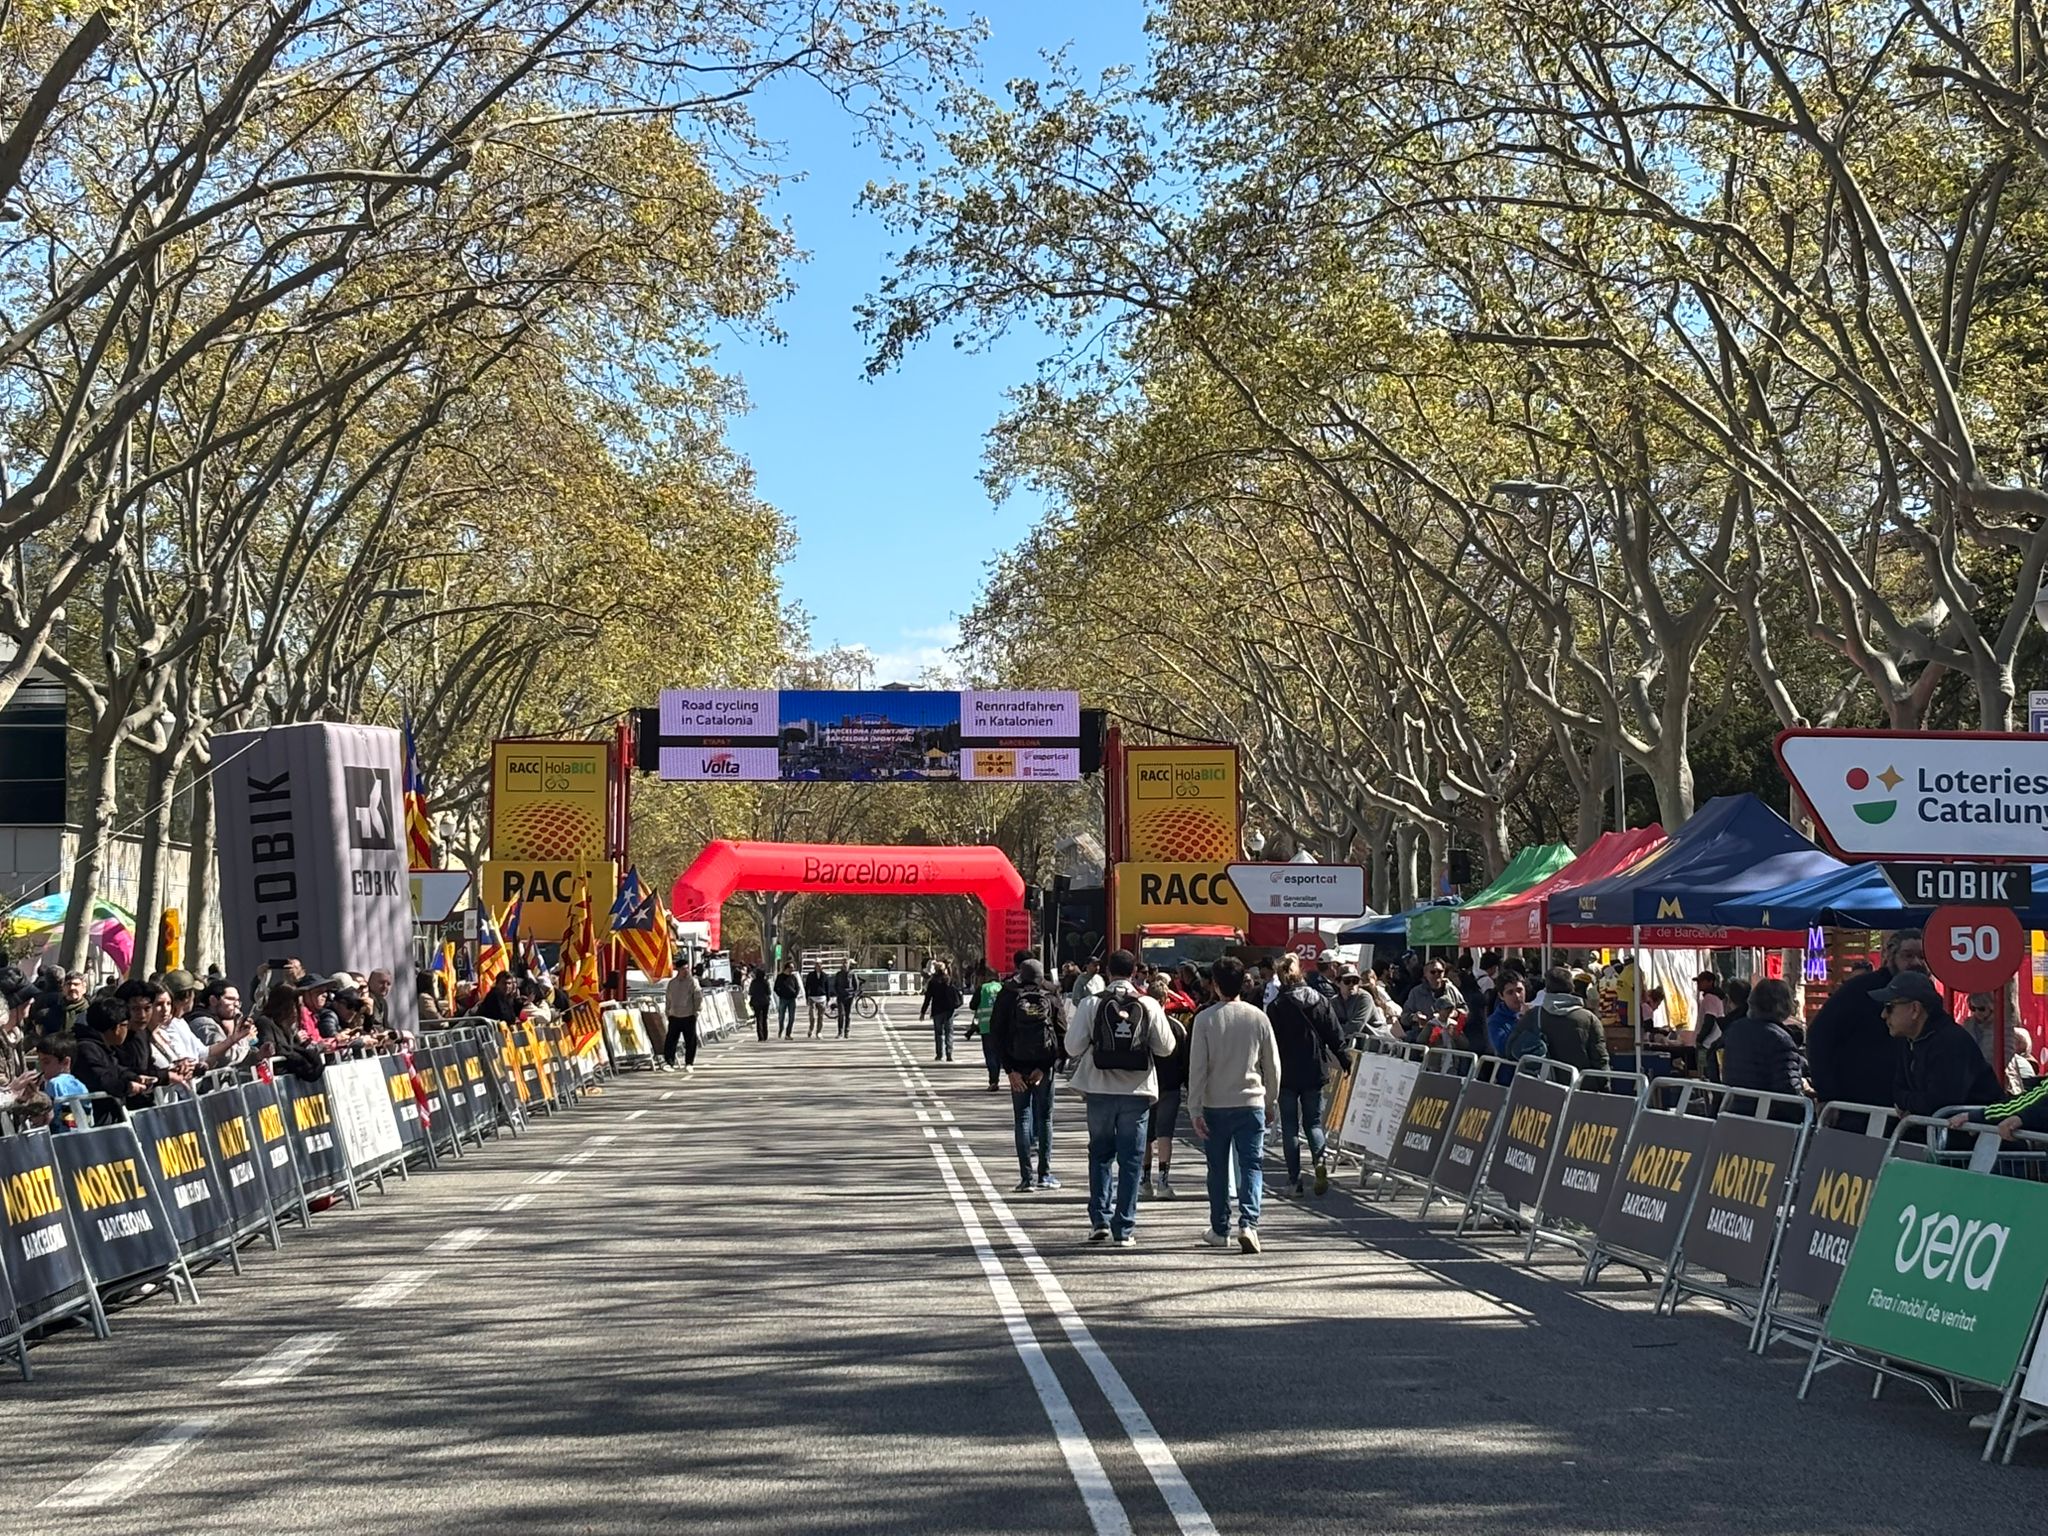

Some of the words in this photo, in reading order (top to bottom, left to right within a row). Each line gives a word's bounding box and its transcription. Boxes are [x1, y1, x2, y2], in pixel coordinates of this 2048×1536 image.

[681, 700, 713, 710] Road
[715, 700, 759, 713] cycling
[681, 715, 692, 725] in
[696, 715, 753, 725] Catalonia
[975, 701, 1065, 711] Rennradfahren
[975, 717, 986, 726] in
[989, 716, 1053, 726] Katalonien
[509, 762, 539, 774] RACC
[545, 762, 596, 774] HolaBICI
[701, 759, 741, 774] Volta
[1140, 770, 1170, 781] RACC
[1175, 768, 1226, 781] HolaBICI
[1918, 767, 2048, 795] Loteries
[247, 771, 299, 942] GOBIK
[803, 856, 919, 885] Barcelona
[352, 870, 399, 896] GOBIK
[1141, 873, 1228, 905] RACC
[1284, 874, 1337, 885] esportcat
[1917, 870, 2009, 900] GOBIK
[1656, 896, 1684, 919] M
[1296, 945, 1316, 959] 25
[1950, 926, 2000, 962] 50
[1408, 1096, 1449, 1129] MORITZ
[1508, 1103, 1552, 1149] MORITZ
[155, 1131, 206, 1180] MORITZ
[1564, 1121, 1618, 1164] MORITZ
[1562, 1167, 1600, 1193] BARCELONA
[1626, 1142, 1692, 1193] MORITZ
[1709, 1152, 1775, 1208] MORITZ
[0, 1165, 62, 1227] MORITZ
[72, 1159, 147, 1212] MORITZ
[1621, 1192, 1667, 1223] BARCELONA
[97, 1208, 154, 1242] BARCELONA
[1707, 1207, 1754, 1243] BARCELONA
[1895, 1204, 2011, 1291] vera
[1867, 1288, 1893, 1310] Fibra
[1926, 1302, 1941, 1323] de
[1941, 1308, 1977, 1332] veritat
